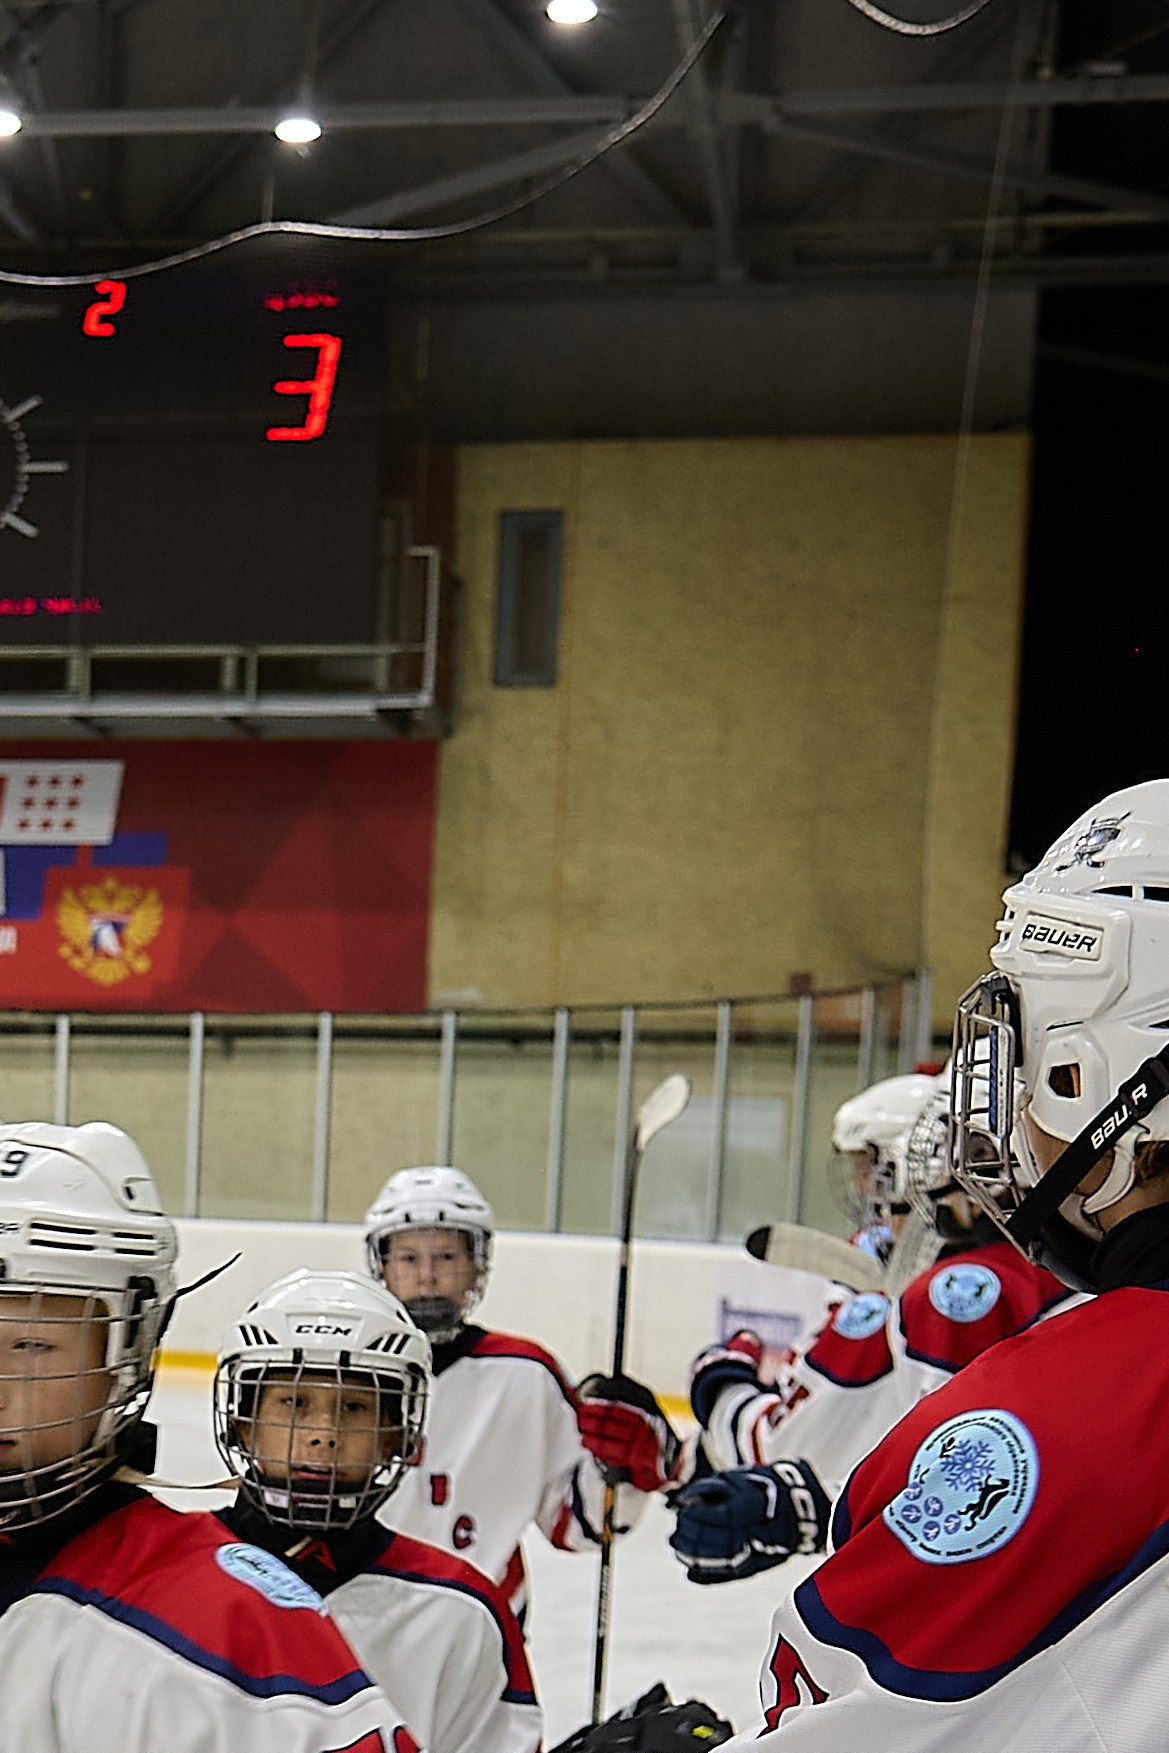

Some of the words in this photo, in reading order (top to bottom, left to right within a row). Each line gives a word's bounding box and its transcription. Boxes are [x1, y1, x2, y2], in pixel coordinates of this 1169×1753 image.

[83, 279, 126, 336] 2
[267, 333, 342, 441] 3
[1022, 923, 1098, 952] BAUER
[1090, 1082, 1148, 1150] BAUR
[295, 1324, 353, 1337] CCM
[772, 1461, 820, 1555] CCM
